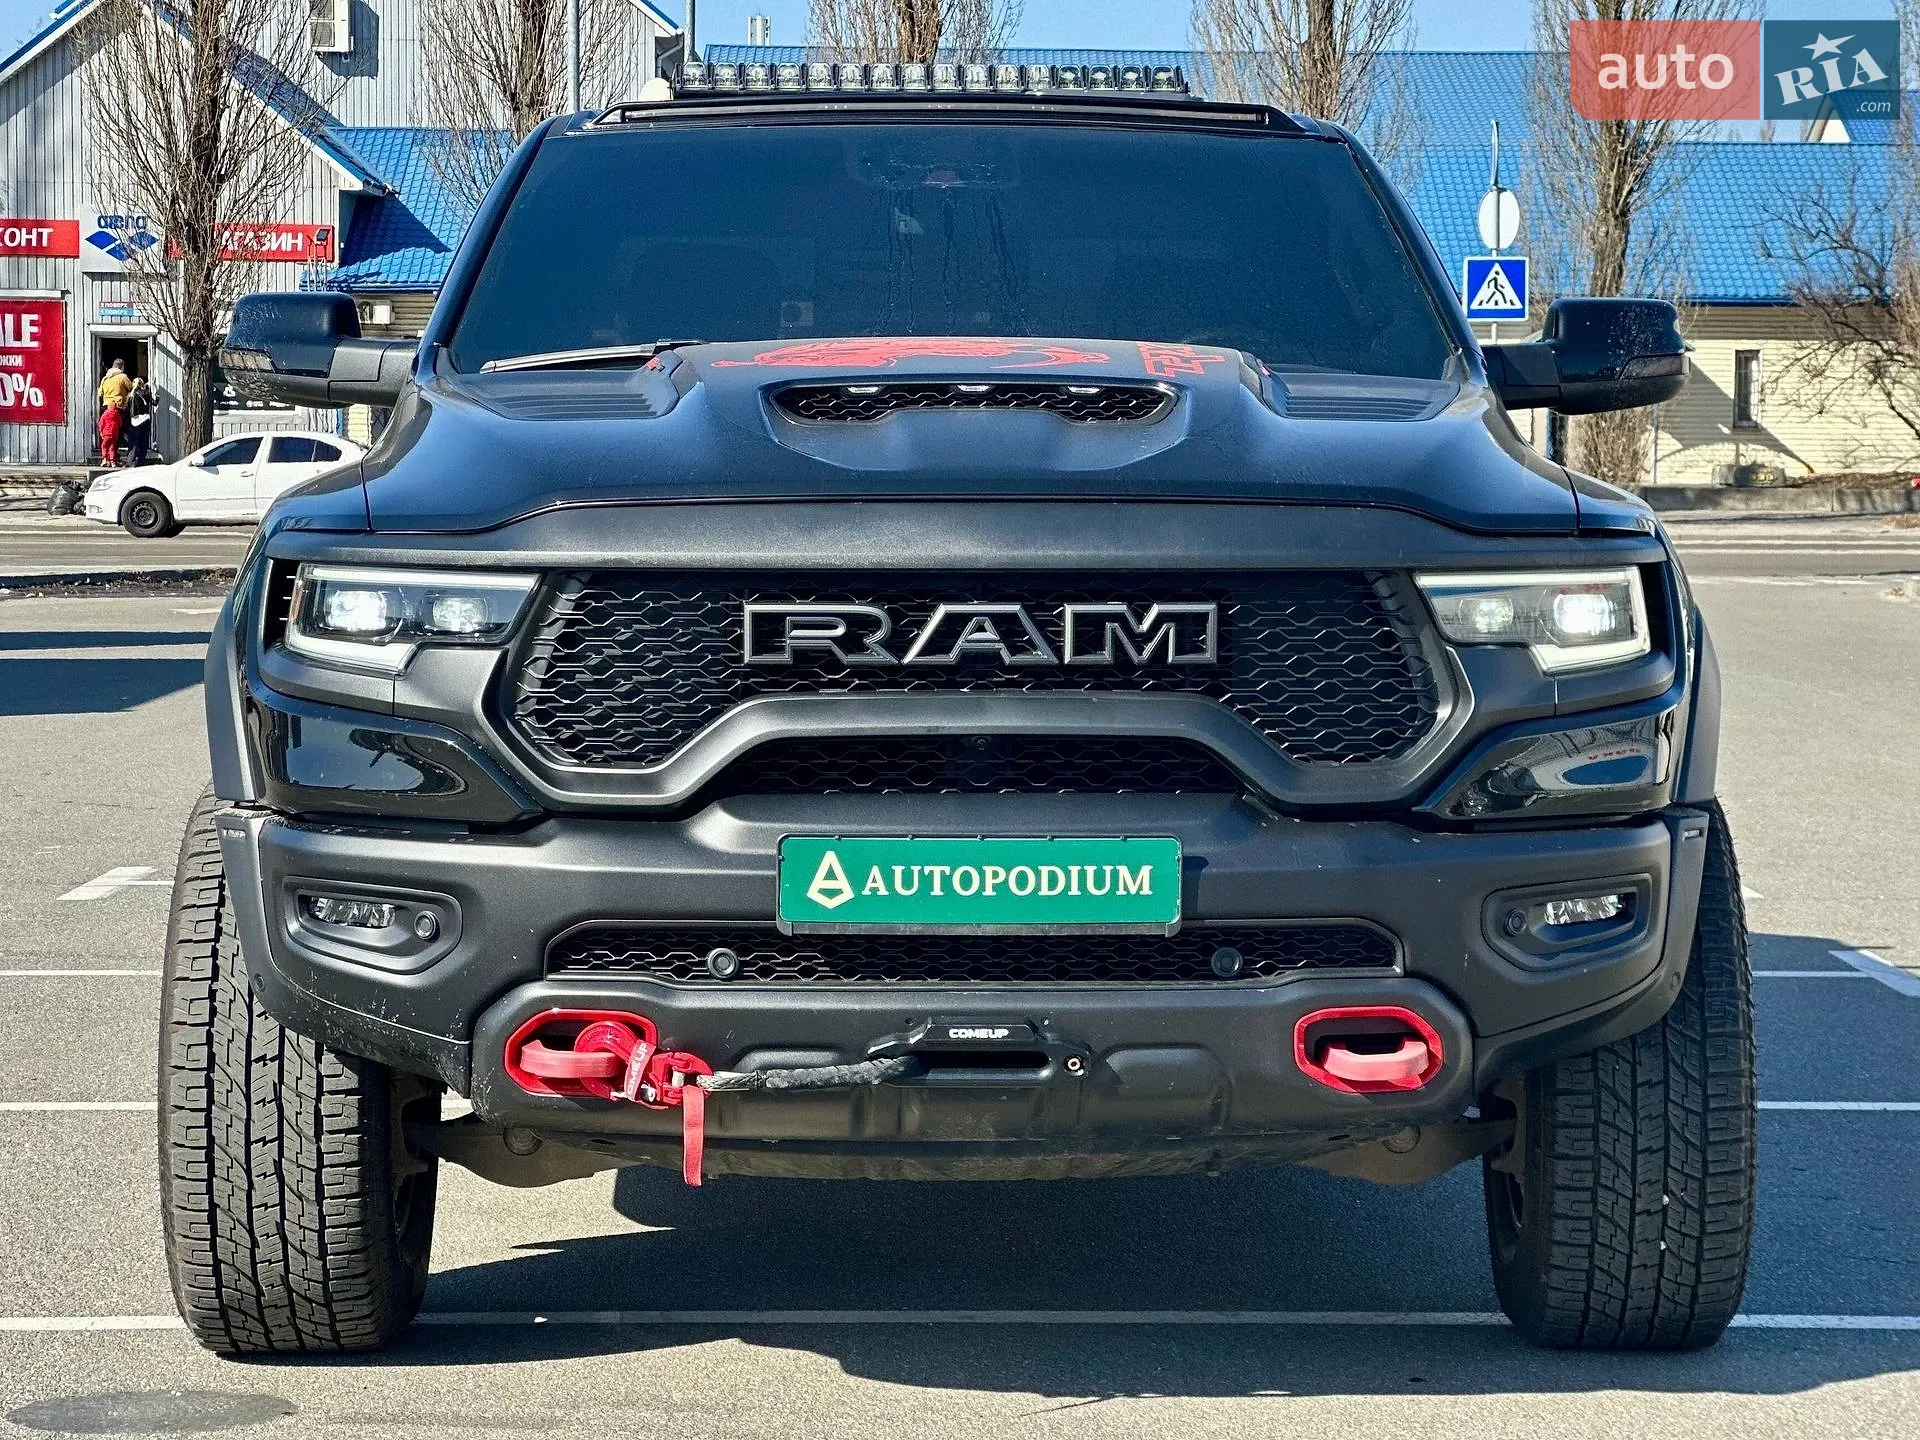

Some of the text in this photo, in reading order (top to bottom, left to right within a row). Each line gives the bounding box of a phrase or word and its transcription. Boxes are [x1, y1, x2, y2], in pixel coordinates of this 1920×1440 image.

[213, 231, 303, 251] АГАЗИН
[744, 603, 1218, 665] RAM
[862, 865, 1154, 897] AUTOPODIUM
[948, 1028, 1010, 1039] COMEUP
[626, 1043, 648, 1097] OMEUP
